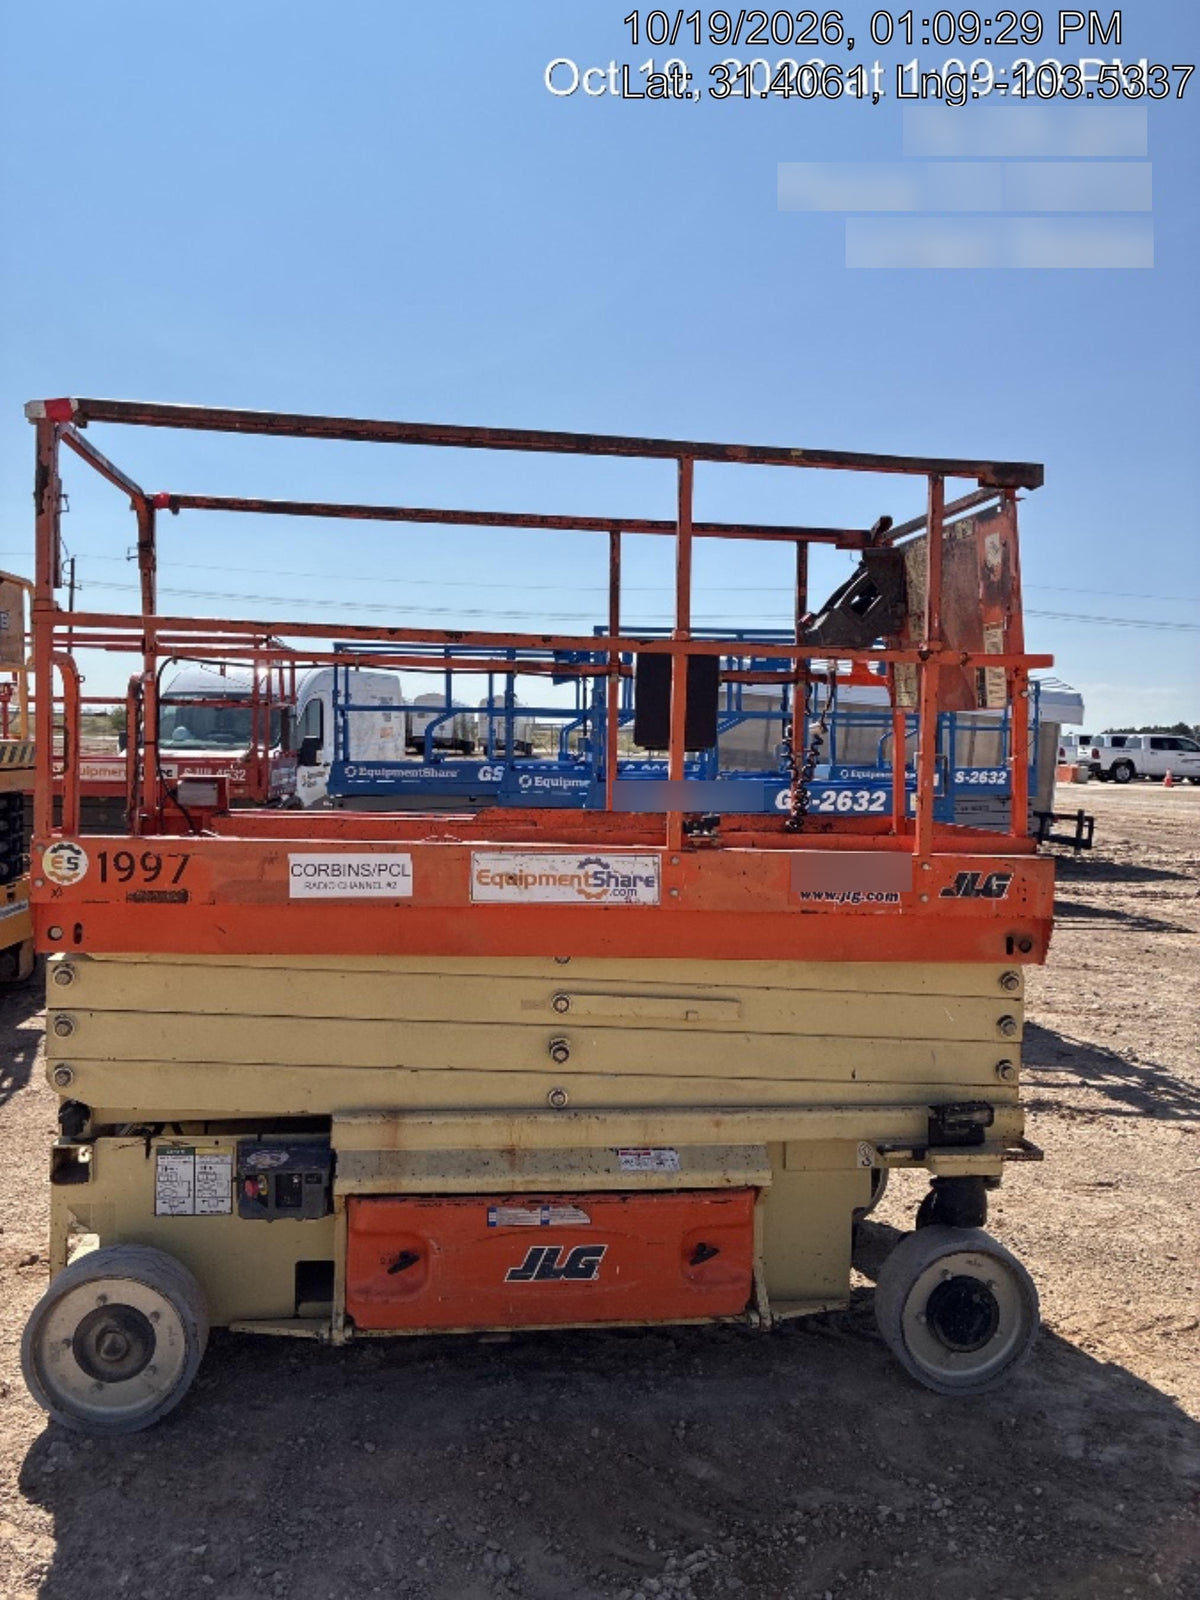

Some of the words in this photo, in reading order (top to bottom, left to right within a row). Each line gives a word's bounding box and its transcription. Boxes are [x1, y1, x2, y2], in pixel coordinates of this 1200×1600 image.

[359, 765, 459, 779] EquipmentShare
[51, 855, 80, 871] ES
[97, 851, 191, 884] 1997
[291, 863, 412, 877] CORBINS/PCL
[304, 881, 335, 890] RADIO
[339, 881, 383, 890] CHANNEL
[476, 869, 656, 889] EquipmentShare
[938, 871, 1014, 899] JLG
[609, 887, 638, 897] .com
[800, 890, 899, 904] www.jlg.com
[504, 1244, 609, 1282] JLG
